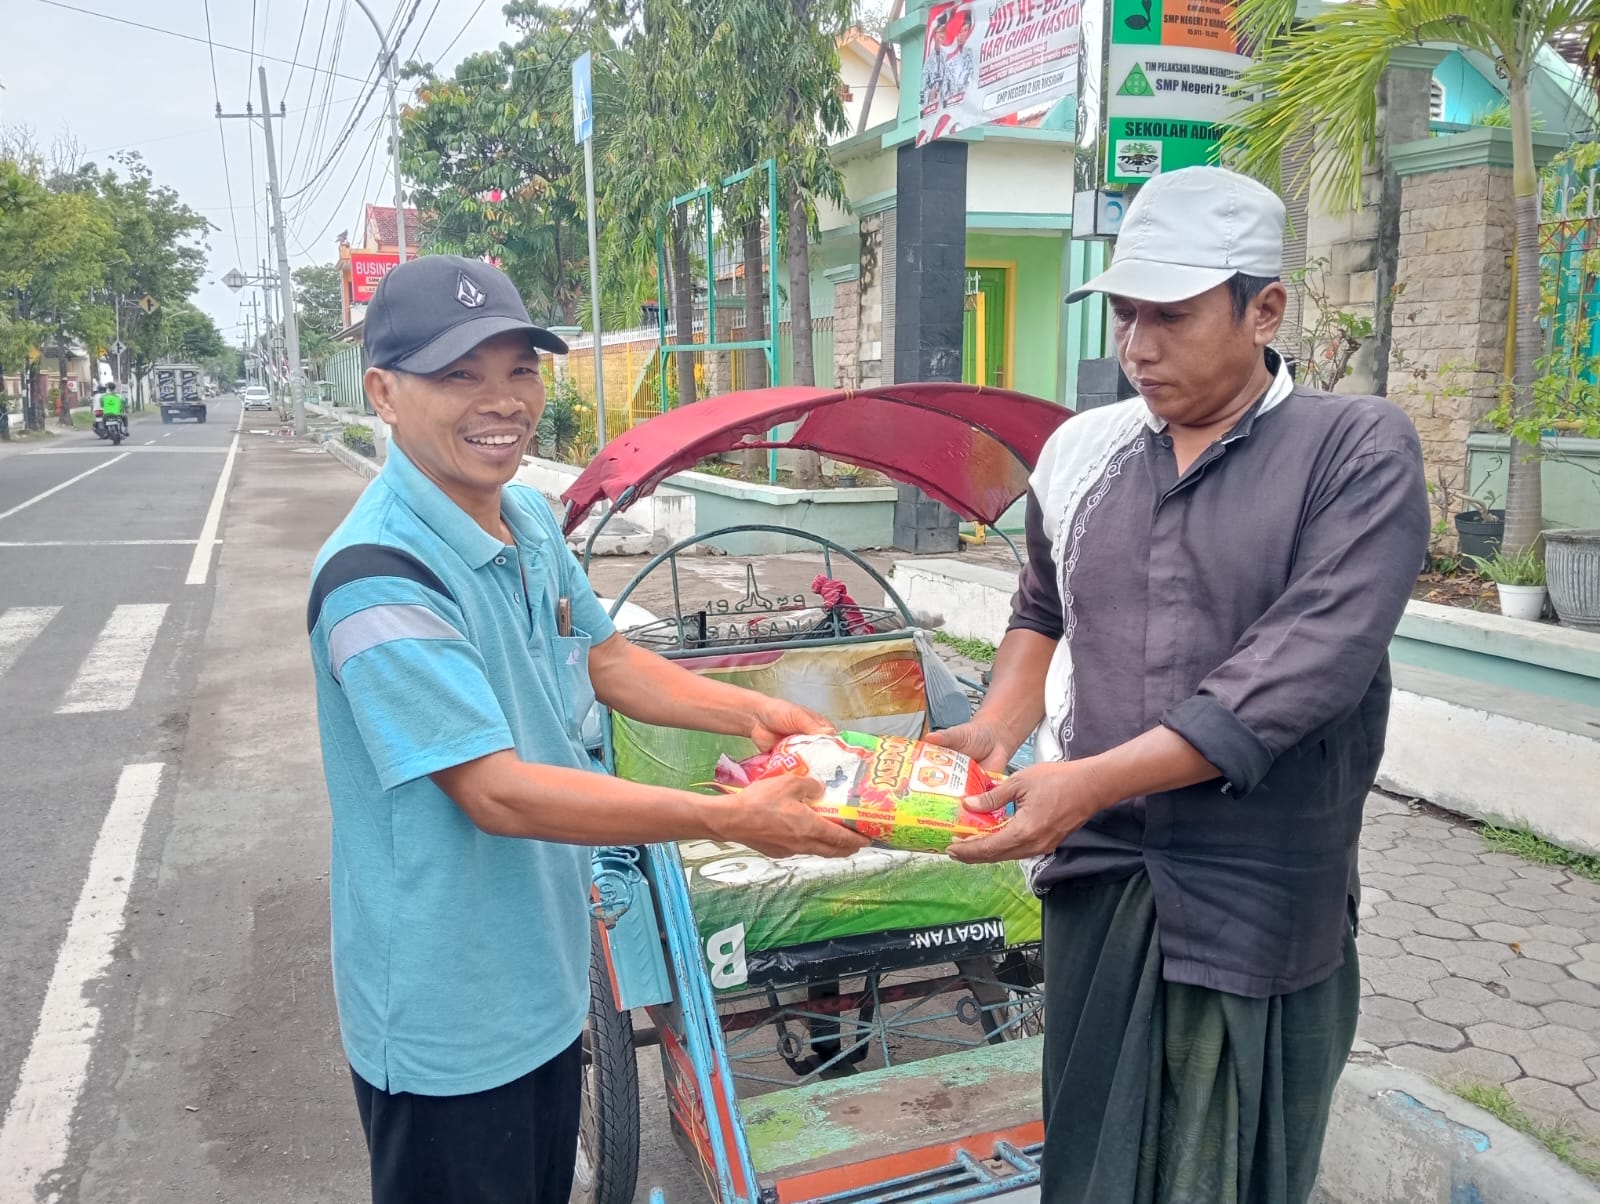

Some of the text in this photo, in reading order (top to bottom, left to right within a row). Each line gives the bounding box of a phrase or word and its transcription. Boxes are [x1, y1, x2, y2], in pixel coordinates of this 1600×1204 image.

[985, 2, 1014, 38] HUT
[1163, 14, 1179, 24] SMP
[1180, 15, 1203, 26] NEGERI
[1203, 18, 1209, 27] 2
[980, 34, 1006, 63] HARI
[1005, 21, 1039, 52] GURU
[1145, 61, 1157, 72] TIM
[1157, 62, 1190, 74] PELAKSANA
[1191, 64, 1209, 76] USAHA
[1155, 78, 1180, 92] SMP
[1181, 79, 1214, 95] Negeri
[1214, 83, 1220, 96] 2
[1125, 121, 1188, 138] SEKOLAH
[909, 920, 1005, 949] INGATAN:
